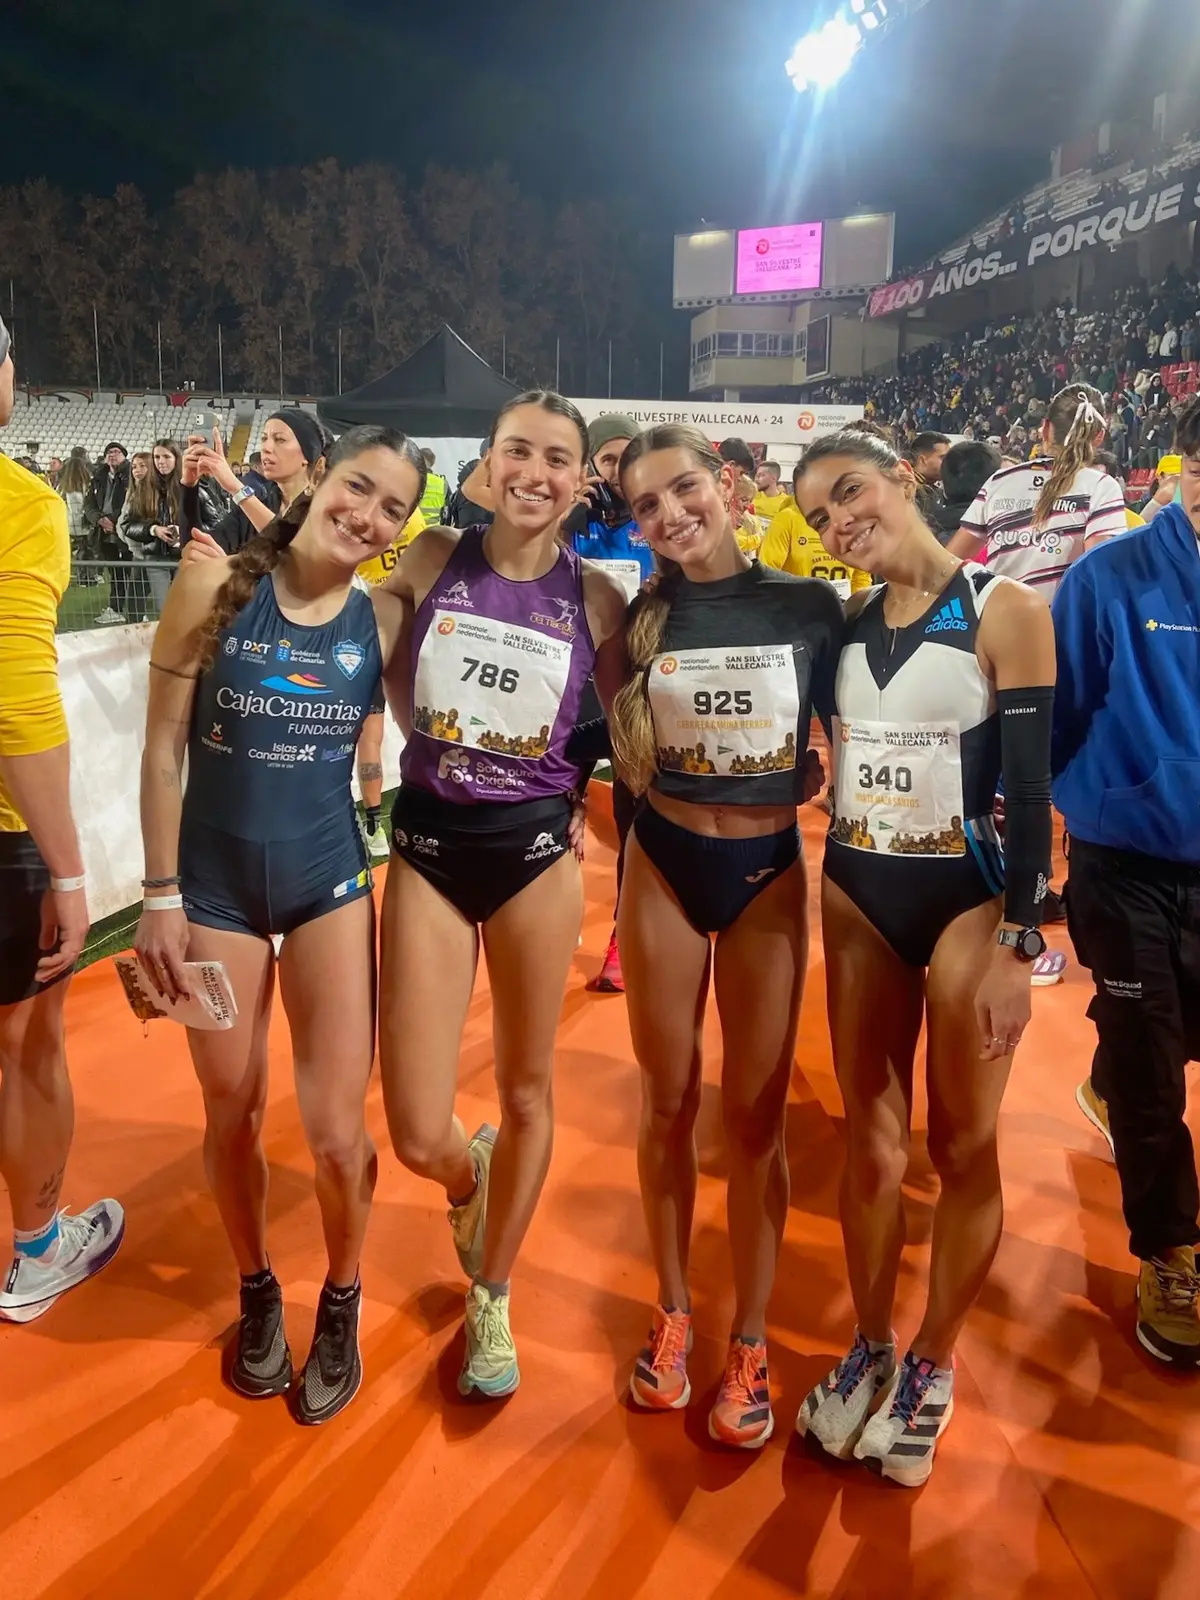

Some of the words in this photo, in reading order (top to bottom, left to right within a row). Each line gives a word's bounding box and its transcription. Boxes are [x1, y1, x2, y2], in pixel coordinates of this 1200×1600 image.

[883, 280, 924, 312] 100
[1027, 182, 1184, 265] PORQUE
[627, 411, 688, 424] SILVESTRE
[691, 413, 760, 425] VALLECANA
[770, 415, 783, 425] 24
[457, 622, 488, 633] nationale
[924, 618, 969, 634] adidas
[1159, 622, 1192, 632] PlayStation
[455, 629, 497, 643] nederlanden
[503, 632, 521, 642] SAN
[521, 637, 561, 654] SILVESTRE
[242, 639, 272, 655] DXT
[291, 649, 320, 658] Gobierno
[502, 639, 547, 657] VALLECANA
[298, 656, 326, 665] Canarias
[680, 657, 711, 665] nationale
[725, 655, 742, 663] SAN
[743, 653, 785, 662] SILVESTRE
[725, 661, 772, 670] VALLECANA
[776, 660, 786, 668] 24
[460, 656, 520, 694] 786
[216, 686, 362, 721] CajaCanarias
[693, 691, 753, 715] 925
[1004, 706, 1037, 715] AEROREADY
[287, 722, 356, 736] FUNDACIÓN
[901, 731, 949, 739] SILVESTRE
[272, 742, 298, 754] Islas
[885, 738, 932, 747] VALLECANA
[938, 738, 949, 746] 24
[248, 749, 296, 762] Canarias
[858, 763, 912, 793] 340
[207, 966, 217, 983] SAN
[211, 983, 230, 1020] SILVESTRE
[214, 1011, 223, 1021] 24
